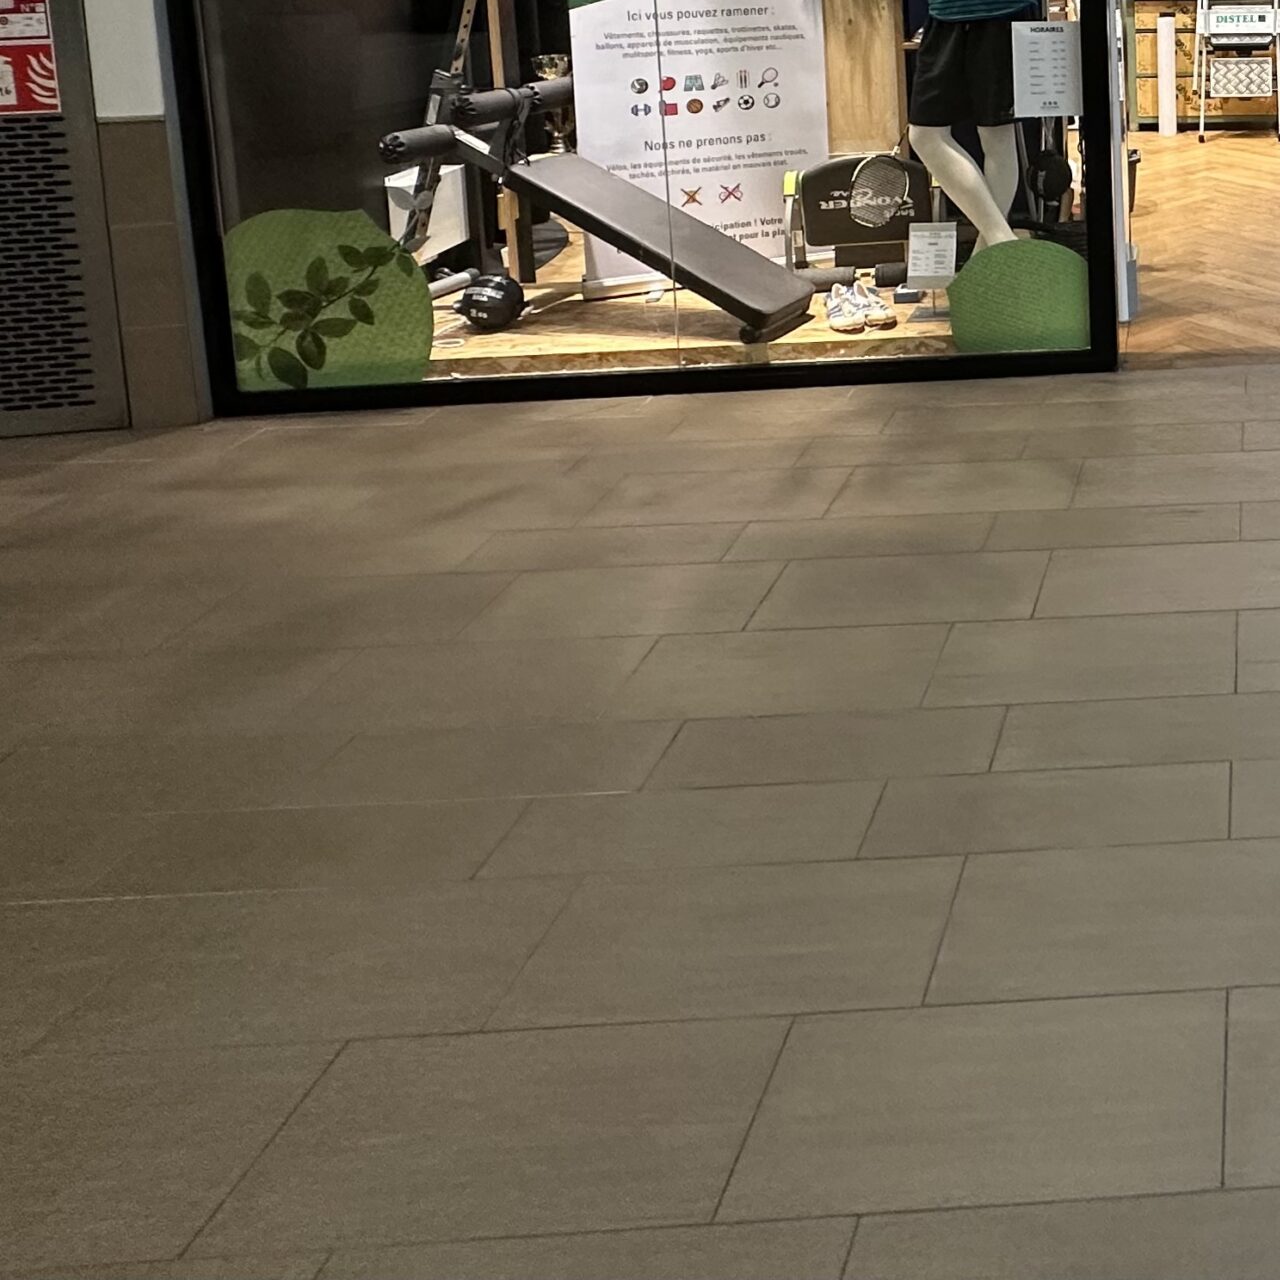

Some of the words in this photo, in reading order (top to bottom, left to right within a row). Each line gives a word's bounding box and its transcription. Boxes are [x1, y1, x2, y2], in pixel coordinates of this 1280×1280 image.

[627, 10, 642, 21] Ici
[645, 11, 673, 21] vous
[677, 9, 718, 22] pouvez
[721, 7, 768, 18] ramener
[1216, 15, 1256, 23] DISTEL
[678, 138, 692, 149] ne
[696, 135, 743, 150] prenons
[746, 133, 767, 145] pas
[709, 219, 753, 232] icipation
[760, 216, 783, 226] Votre
[739, 231, 759, 242] pour
[762, 229, 770, 238] la
[772, 228, 786, 241] pla
